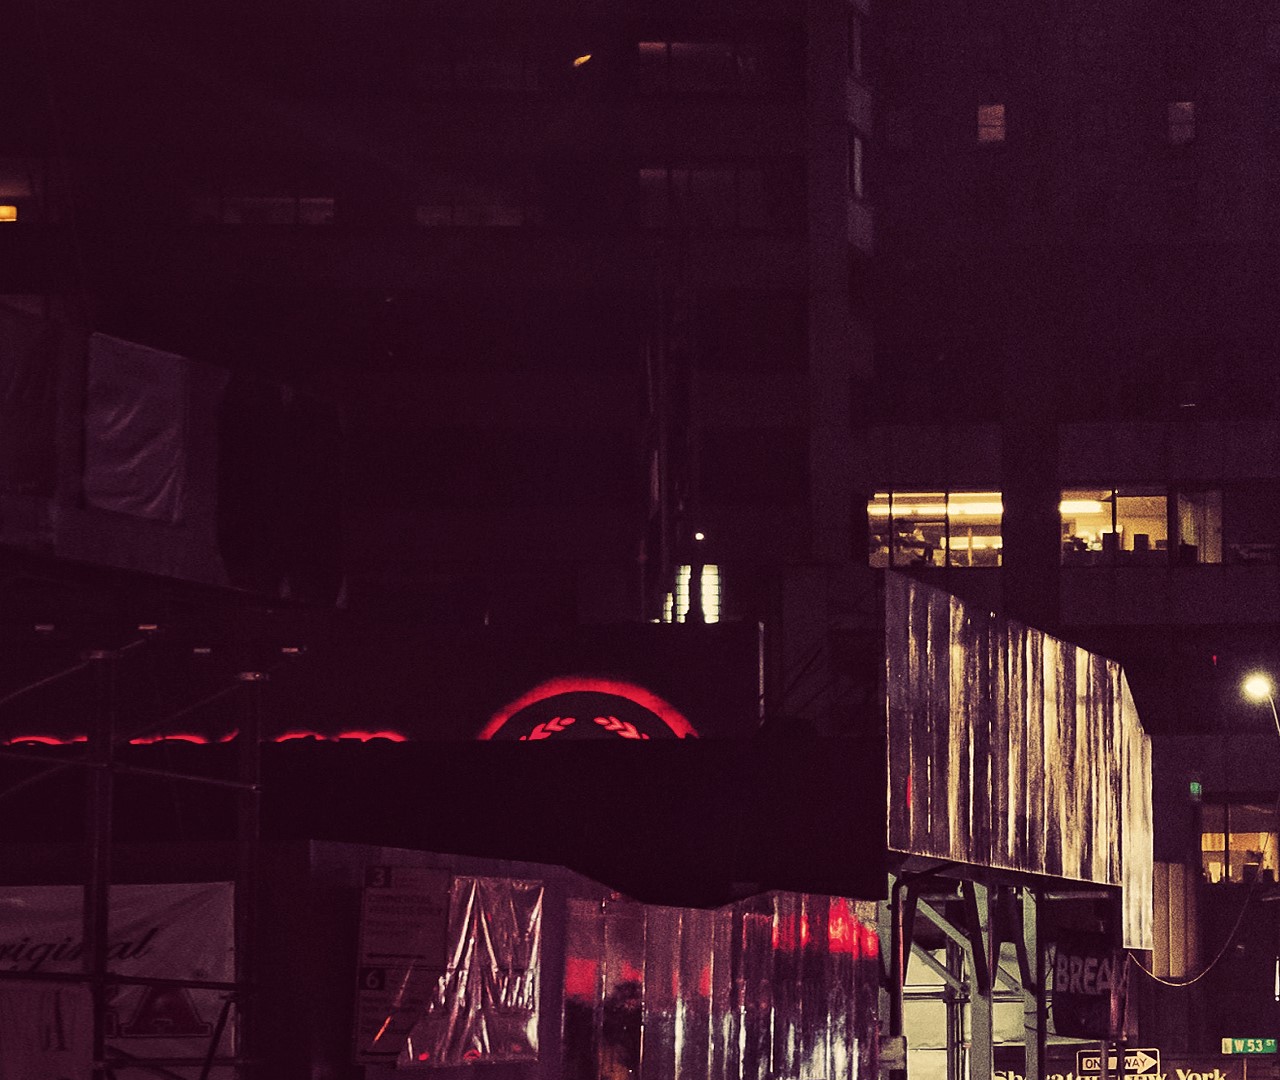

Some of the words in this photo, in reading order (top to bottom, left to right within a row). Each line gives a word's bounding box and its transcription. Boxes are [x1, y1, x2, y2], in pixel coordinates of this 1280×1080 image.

[1234, 1040, 1245, 1052] W
[1247, 1040, 1263, 1052] 53
[1266, 1039, 1276, 1047] ST
[1124, 1057, 1148, 1069] WAY
